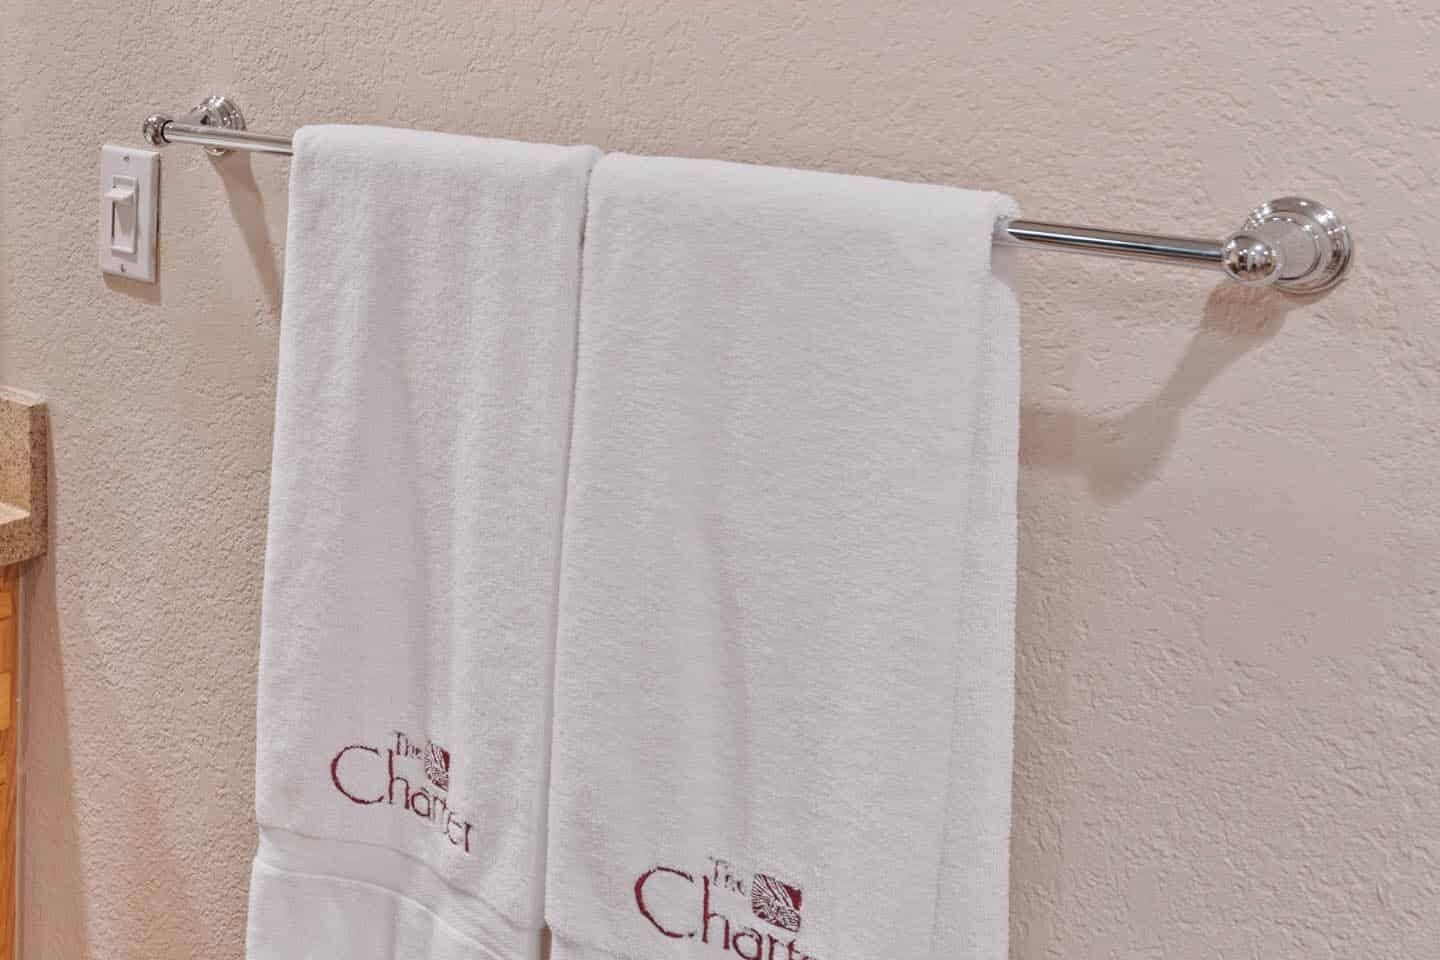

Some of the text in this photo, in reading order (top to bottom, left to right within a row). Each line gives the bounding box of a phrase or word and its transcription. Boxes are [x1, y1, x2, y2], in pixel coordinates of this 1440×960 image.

[395, 730, 424, 760] The
[331, 744, 472, 854] Charter
[707, 855, 746, 896] The
[634, 866, 817, 960] Chart
